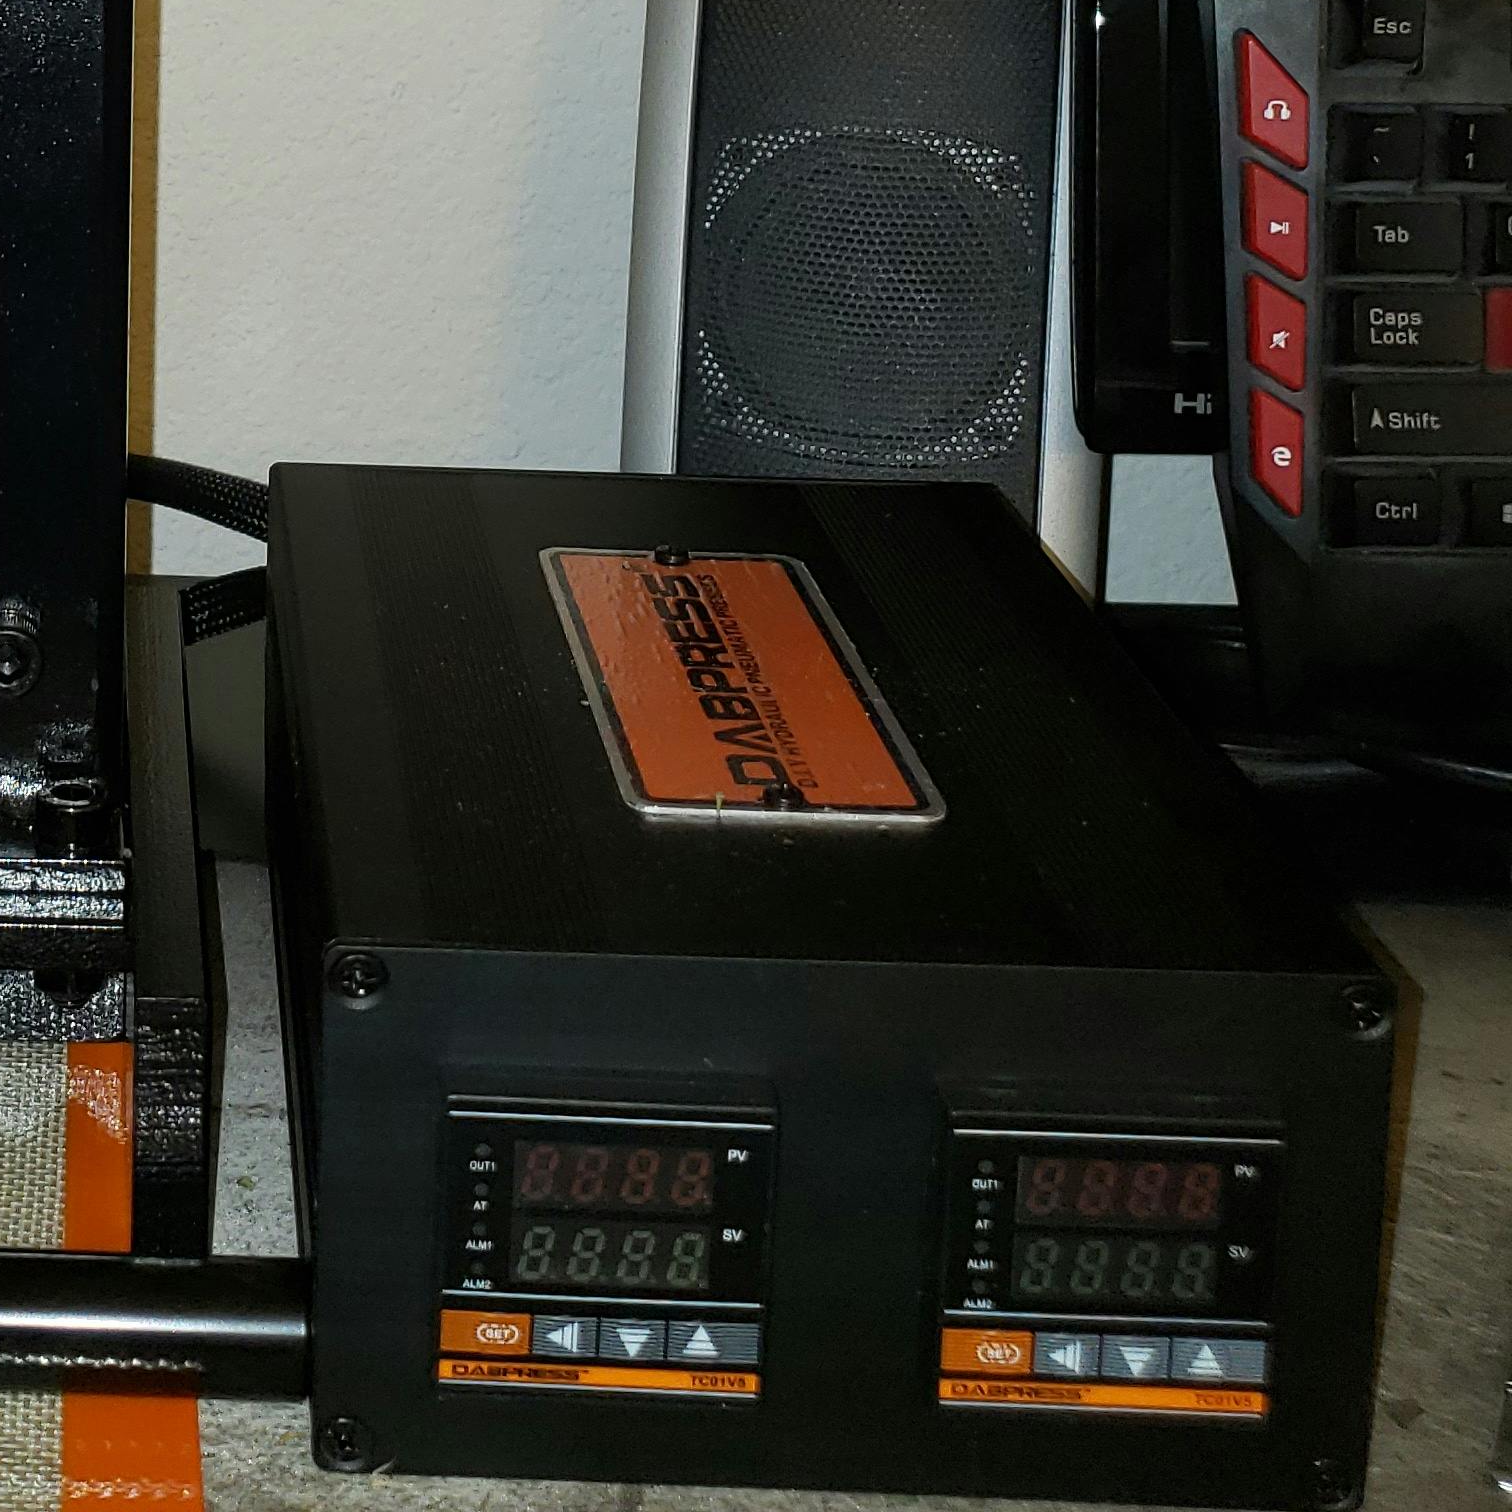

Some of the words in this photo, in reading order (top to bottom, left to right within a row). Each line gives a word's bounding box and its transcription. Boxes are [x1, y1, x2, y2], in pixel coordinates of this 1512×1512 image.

[1373, 18, 1411, 34] Esc
[1465, 152, 1474, 169] 1
[1373, 225, 1409, 243] Tab
[1369, 307, 1422, 329] Caps
[1370, 328, 1419, 345] Lock
[1388, 411, 1441, 430] Shift
[1376, 502, 1418, 520] Ctrl
[727, 1149, 748, 1162] PV
[469, 1160, 497, 1172] OUT1
[473, 1200, 487, 1211] AT
[722, 1229, 743, 1241] SV
[465, 1239, 493, 1251] ALM1
[462, 1278, 492, 1290] ALM2
